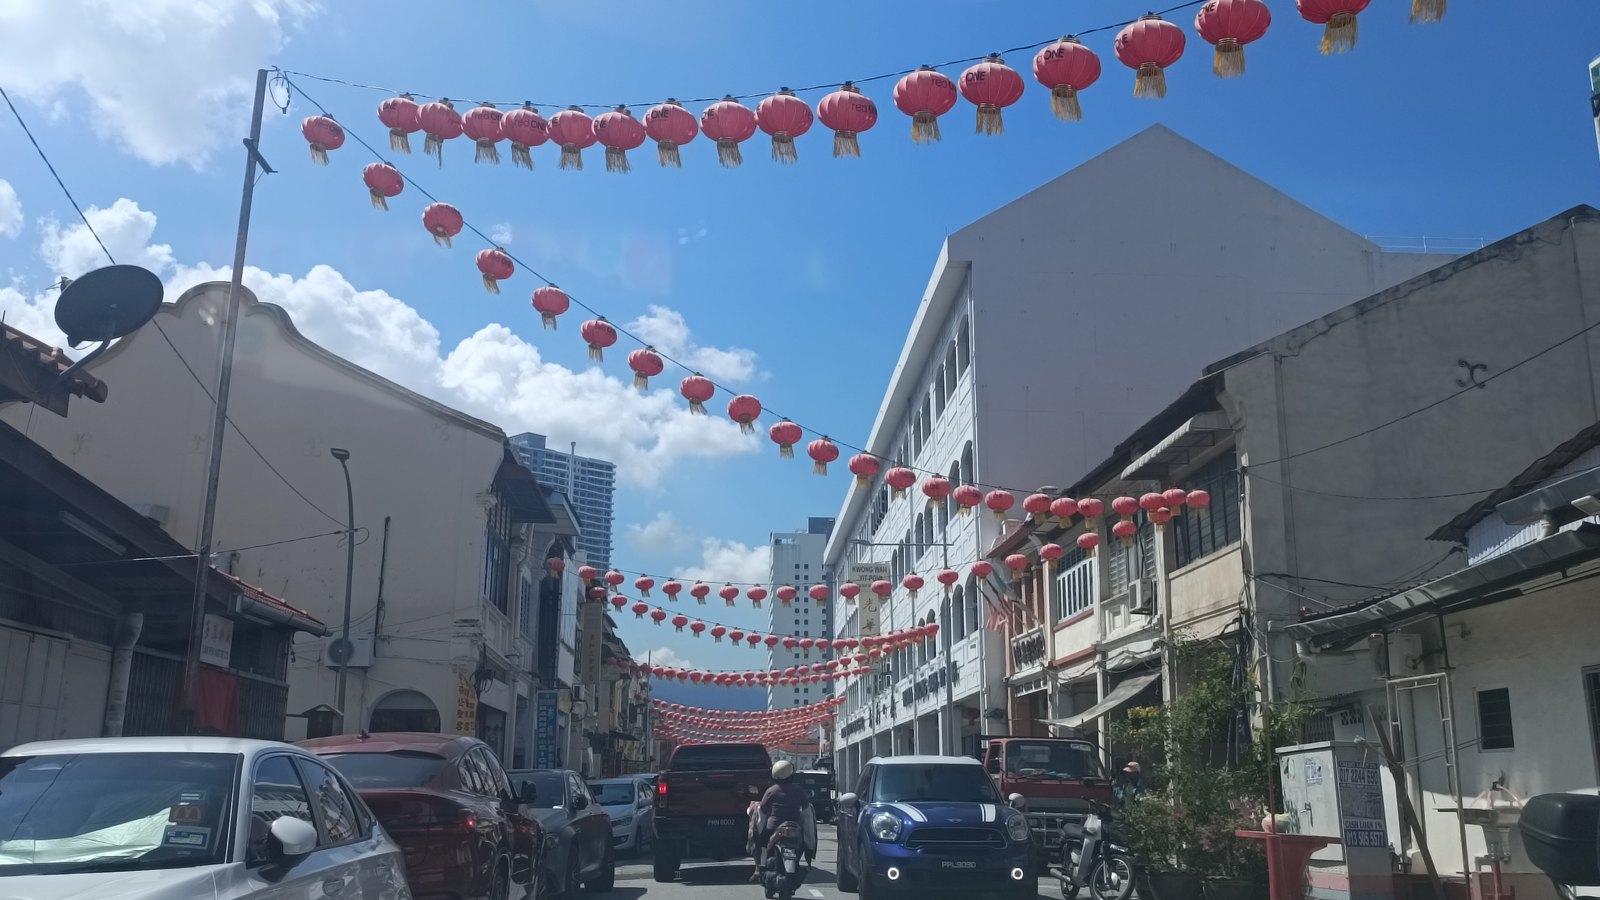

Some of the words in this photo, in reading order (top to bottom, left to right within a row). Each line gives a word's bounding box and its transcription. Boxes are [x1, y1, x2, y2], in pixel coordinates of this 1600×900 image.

[1044, 48, 1065, 60] ONE
[965, 71, 986, 82] ONE
[651, 109, 670, 119] ONE
[852, 565, 873, 573] KWONG
